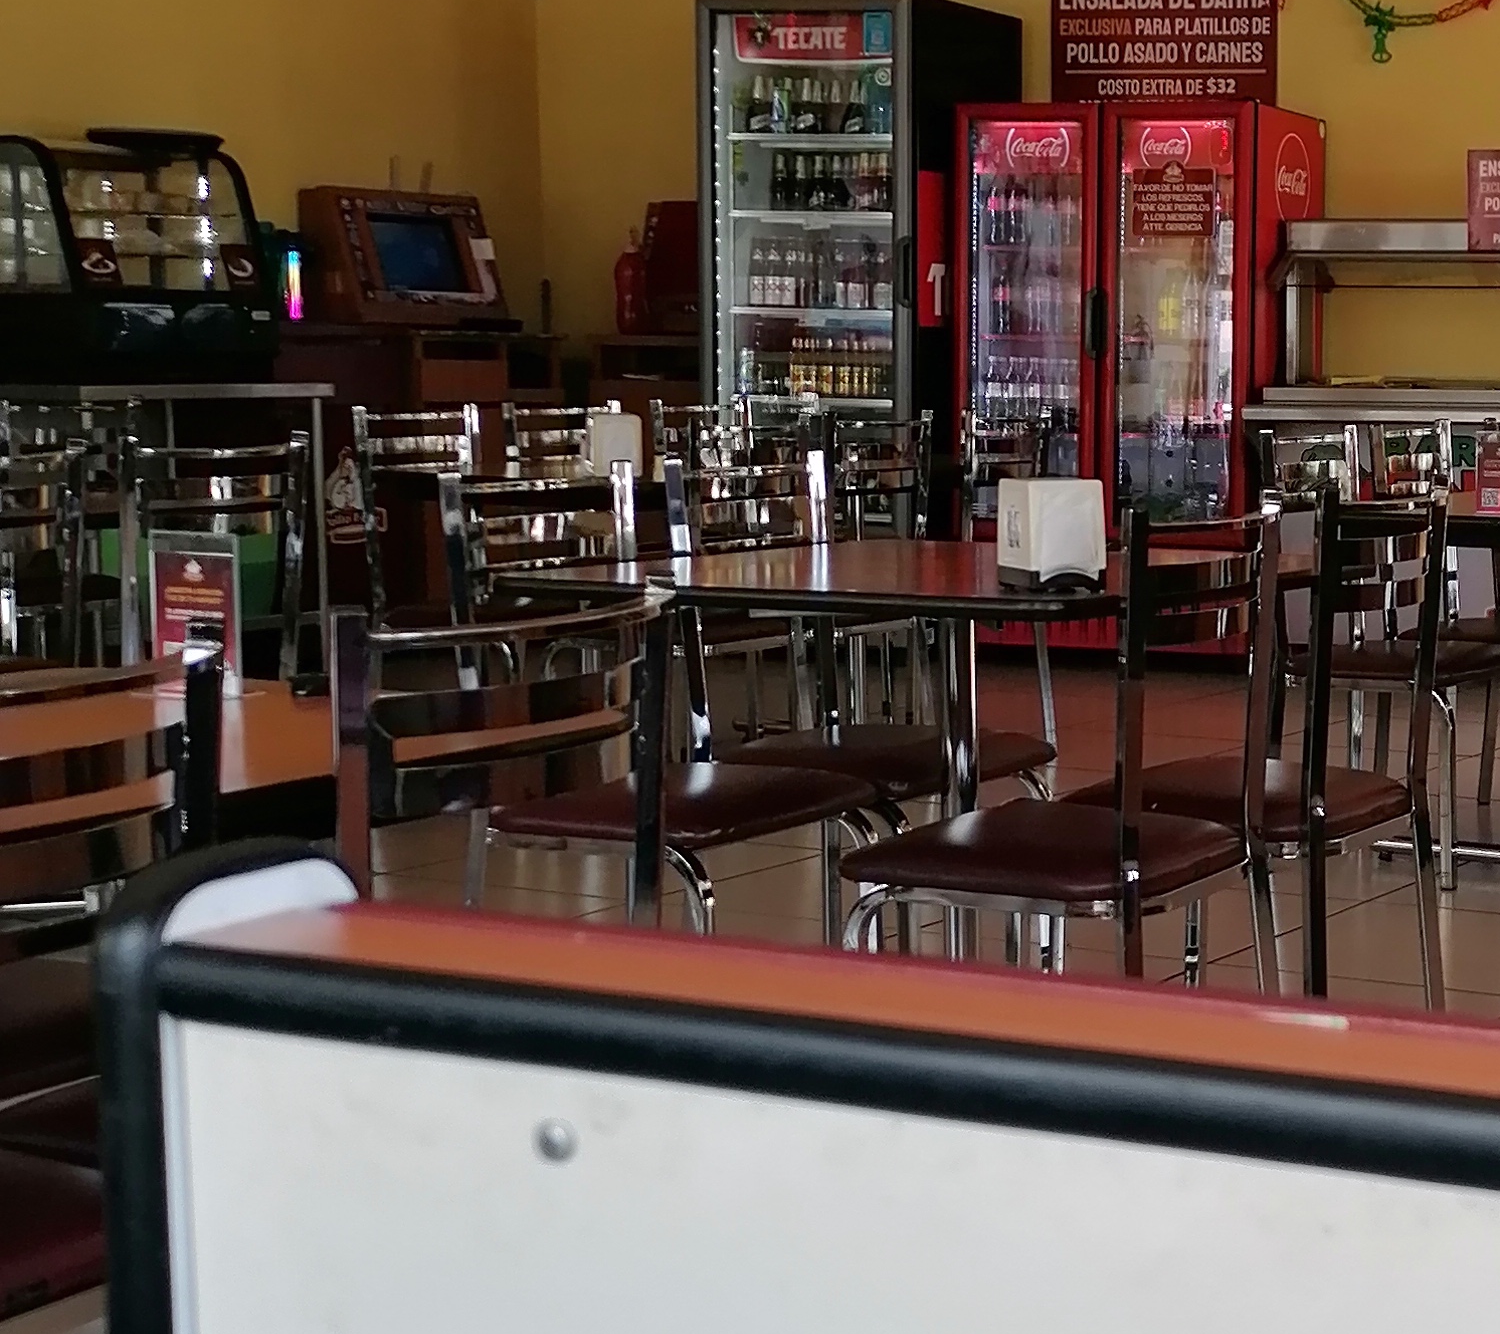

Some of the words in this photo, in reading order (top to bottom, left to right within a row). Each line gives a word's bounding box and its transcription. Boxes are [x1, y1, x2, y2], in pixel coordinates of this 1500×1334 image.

[1060, 17, 1132, 36] EXCLUSIVA
[1135, 17, 1171, 36] PARA
[1174, 17, 1249, 35] PLATILLOS
[1252, 16, 1270, 35] DE
[771, 26, 848, 50] TECATE
[1066, 43, 1120, 64] POLLO
[1123, 42, 1178, 64] ASADO
[1181, 42, 1192, 63] Y
[1195, 41, 1263, 63] CARNES
[1098, 78, 1140, 96] COSTO
[1142, 78, 1183, 96] EXTRA
[1186, 78, 1203, 96] DE
[1206, 77, 1236, 95] $32
[1173, 183, 1184, 192] NO
